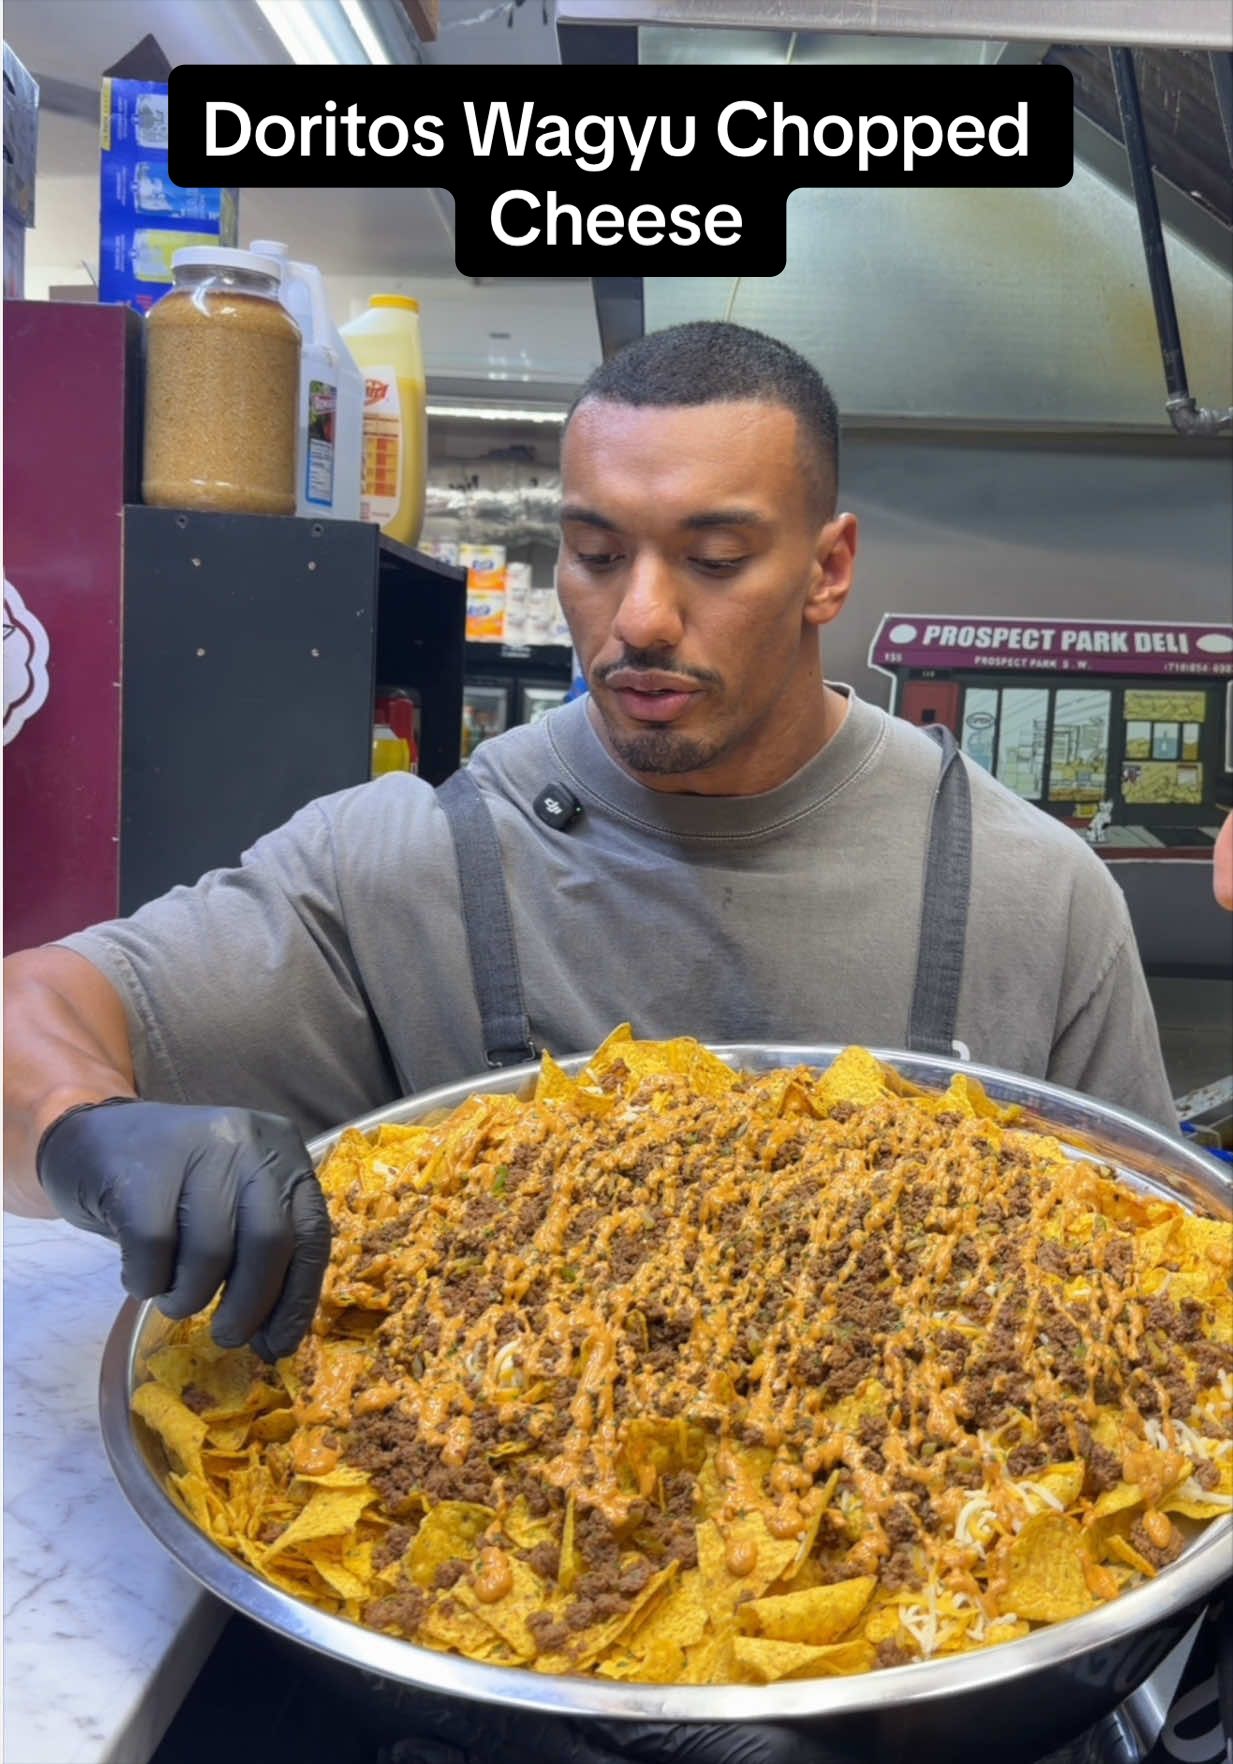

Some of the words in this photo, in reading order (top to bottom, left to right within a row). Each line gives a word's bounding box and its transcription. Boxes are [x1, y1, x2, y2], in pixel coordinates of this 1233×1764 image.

[921, 625, 1054, 651] PROSPECT
[1060, 630, 1129, 653] PARK
[1133, 632, 1190, 655] DELI
[974, 655, 1028, 667] PROSPECT
[1029, 657, 1057, 669] PARK
